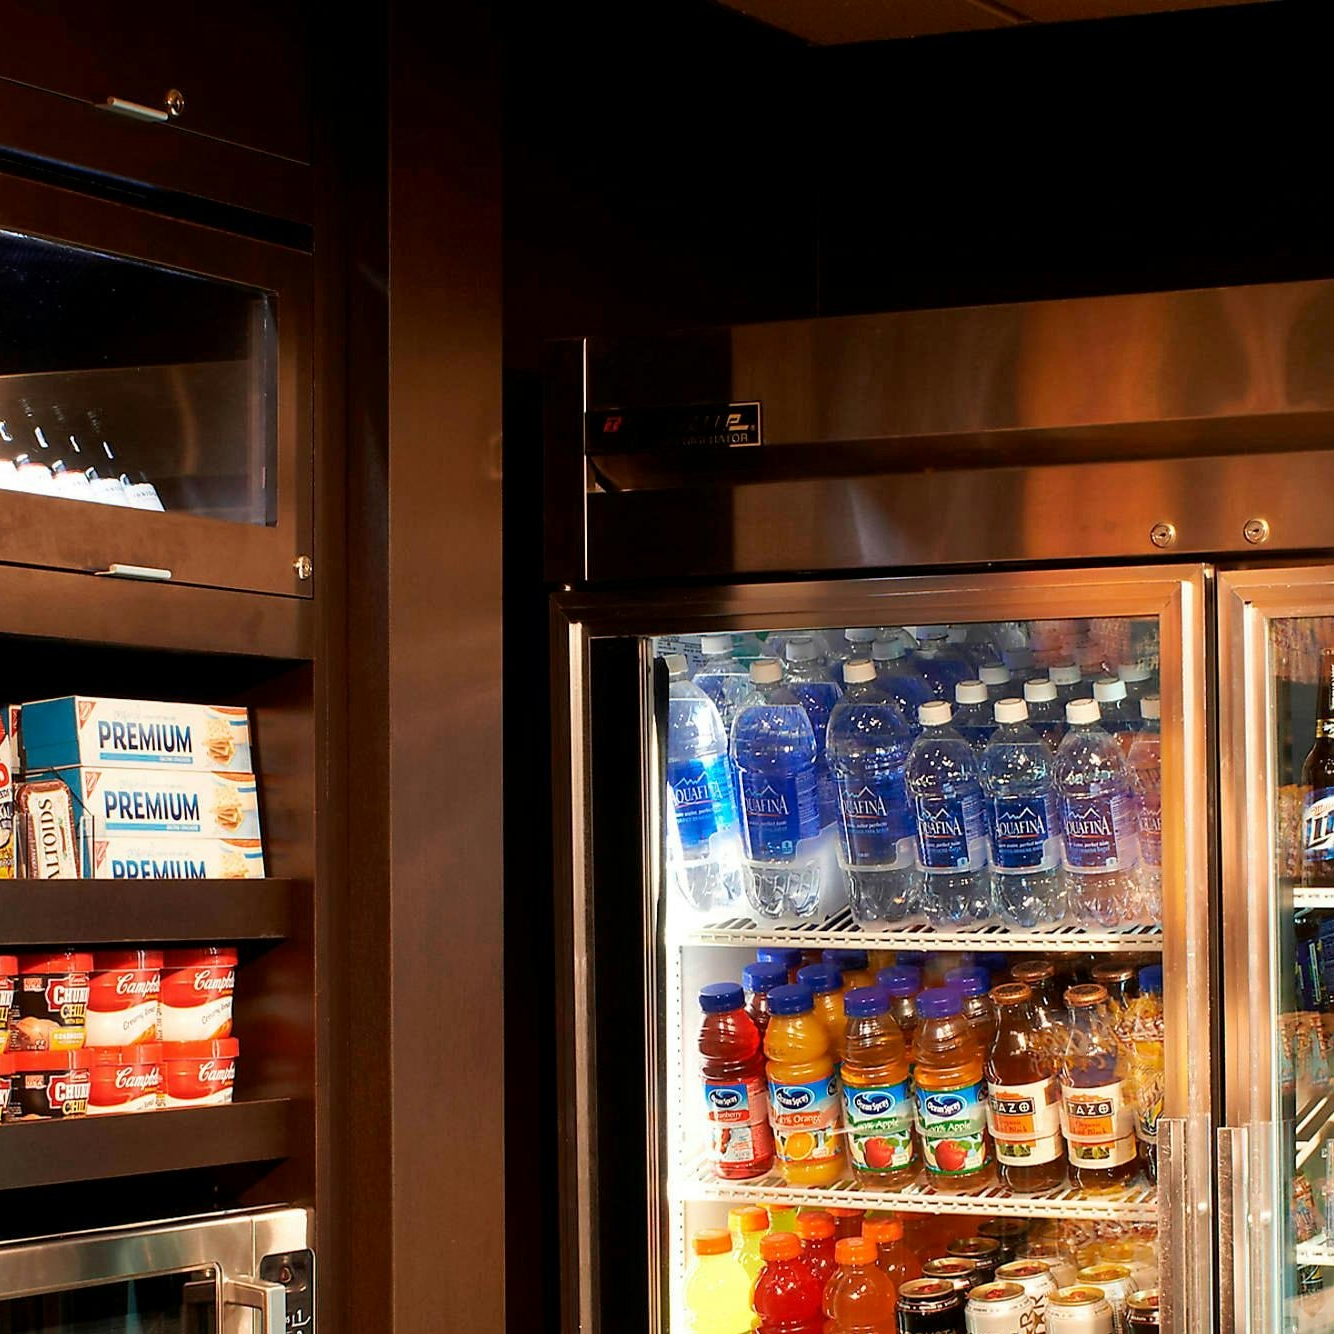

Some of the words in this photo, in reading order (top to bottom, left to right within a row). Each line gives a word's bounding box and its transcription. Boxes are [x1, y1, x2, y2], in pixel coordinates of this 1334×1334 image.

[98, 720, 192, 754] PREMIUM
[103, 789, 200, 822] PREMIUM
[39, 798, 61, 879] ALTOIDS
[995, 816, 1045, 838] AQUAFINA
[1069, 1102, 1110, 1116] TAZO
[296, 1310, 304, 1322] 1
